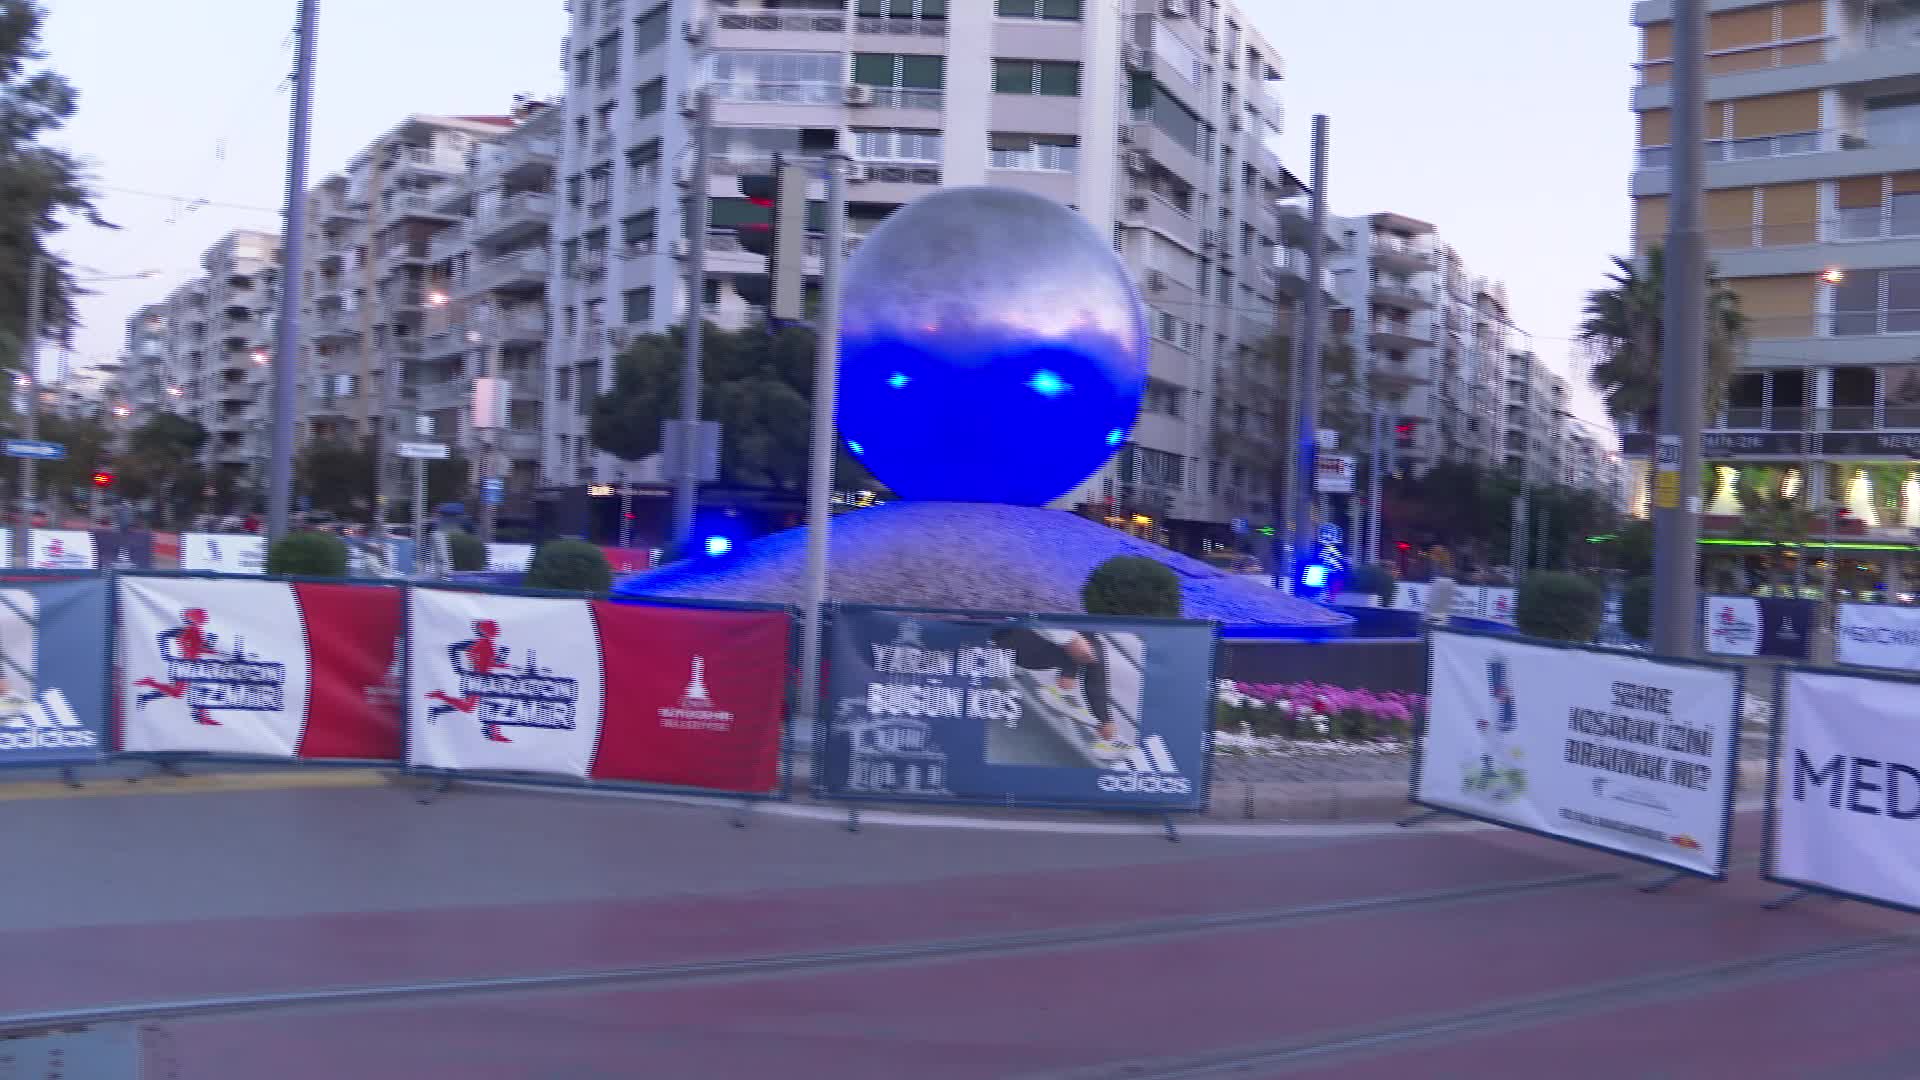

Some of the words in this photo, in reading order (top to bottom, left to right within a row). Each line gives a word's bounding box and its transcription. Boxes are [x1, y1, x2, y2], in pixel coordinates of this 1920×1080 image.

[1659, 443, 1680, 464] 20
[172, 661, 282, 685] MARATON
[871, 643, 956, 676] YARIN
[956, 640, 1017, 688] İÇİN
[463, 675, 577, 703] MARATON
[867, 679, 964, 719] BUGÜN
[966, 688, 1024, 729] KOŞ
[1611, 680, 1673, 717] ŞEHRE
[0, 727, 98, 750] adidas
[1568, 705, 1660, 749] KOŞARAK
[1097, 771, 1192, 795] adidas
[1564, 738, 1667, 785] BIRAKMAK
[1668, 760, 1712, 792] MI?
[1793, 748, 1920, 821] MED
